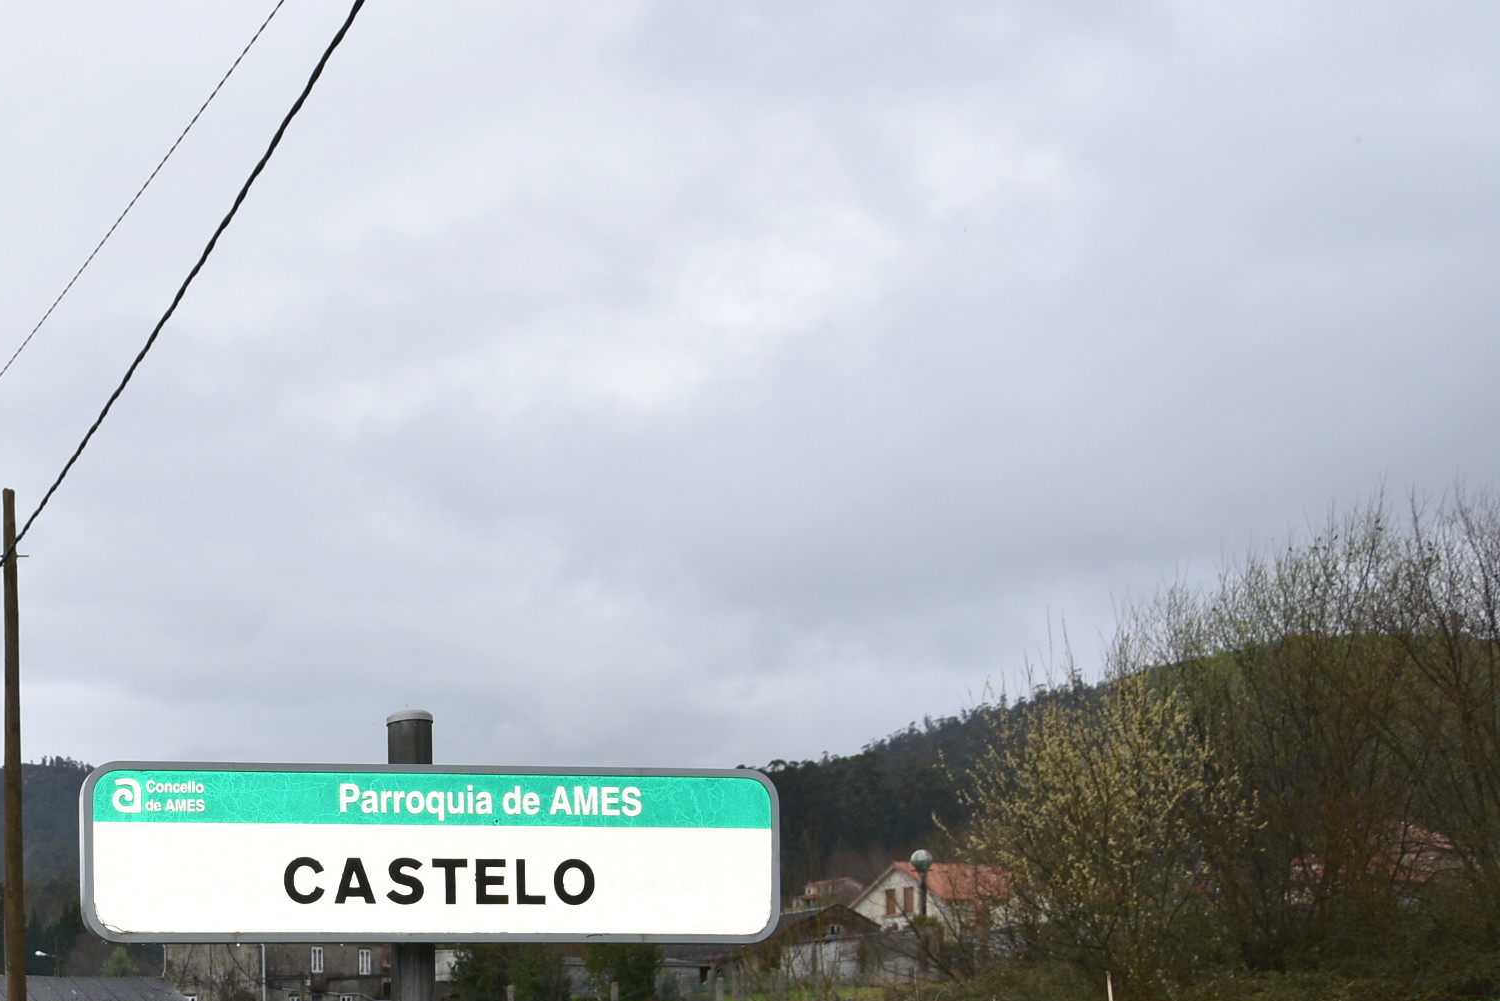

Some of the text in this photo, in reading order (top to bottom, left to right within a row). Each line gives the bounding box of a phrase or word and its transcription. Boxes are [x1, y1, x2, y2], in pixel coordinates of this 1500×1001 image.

[145, 779, 205, 794] Concello
[145, 798, 206, 813] de AMES
[339, 782, 643, 821] Parroquia de AMES
[283, 856, 595, 906] CASTELO
